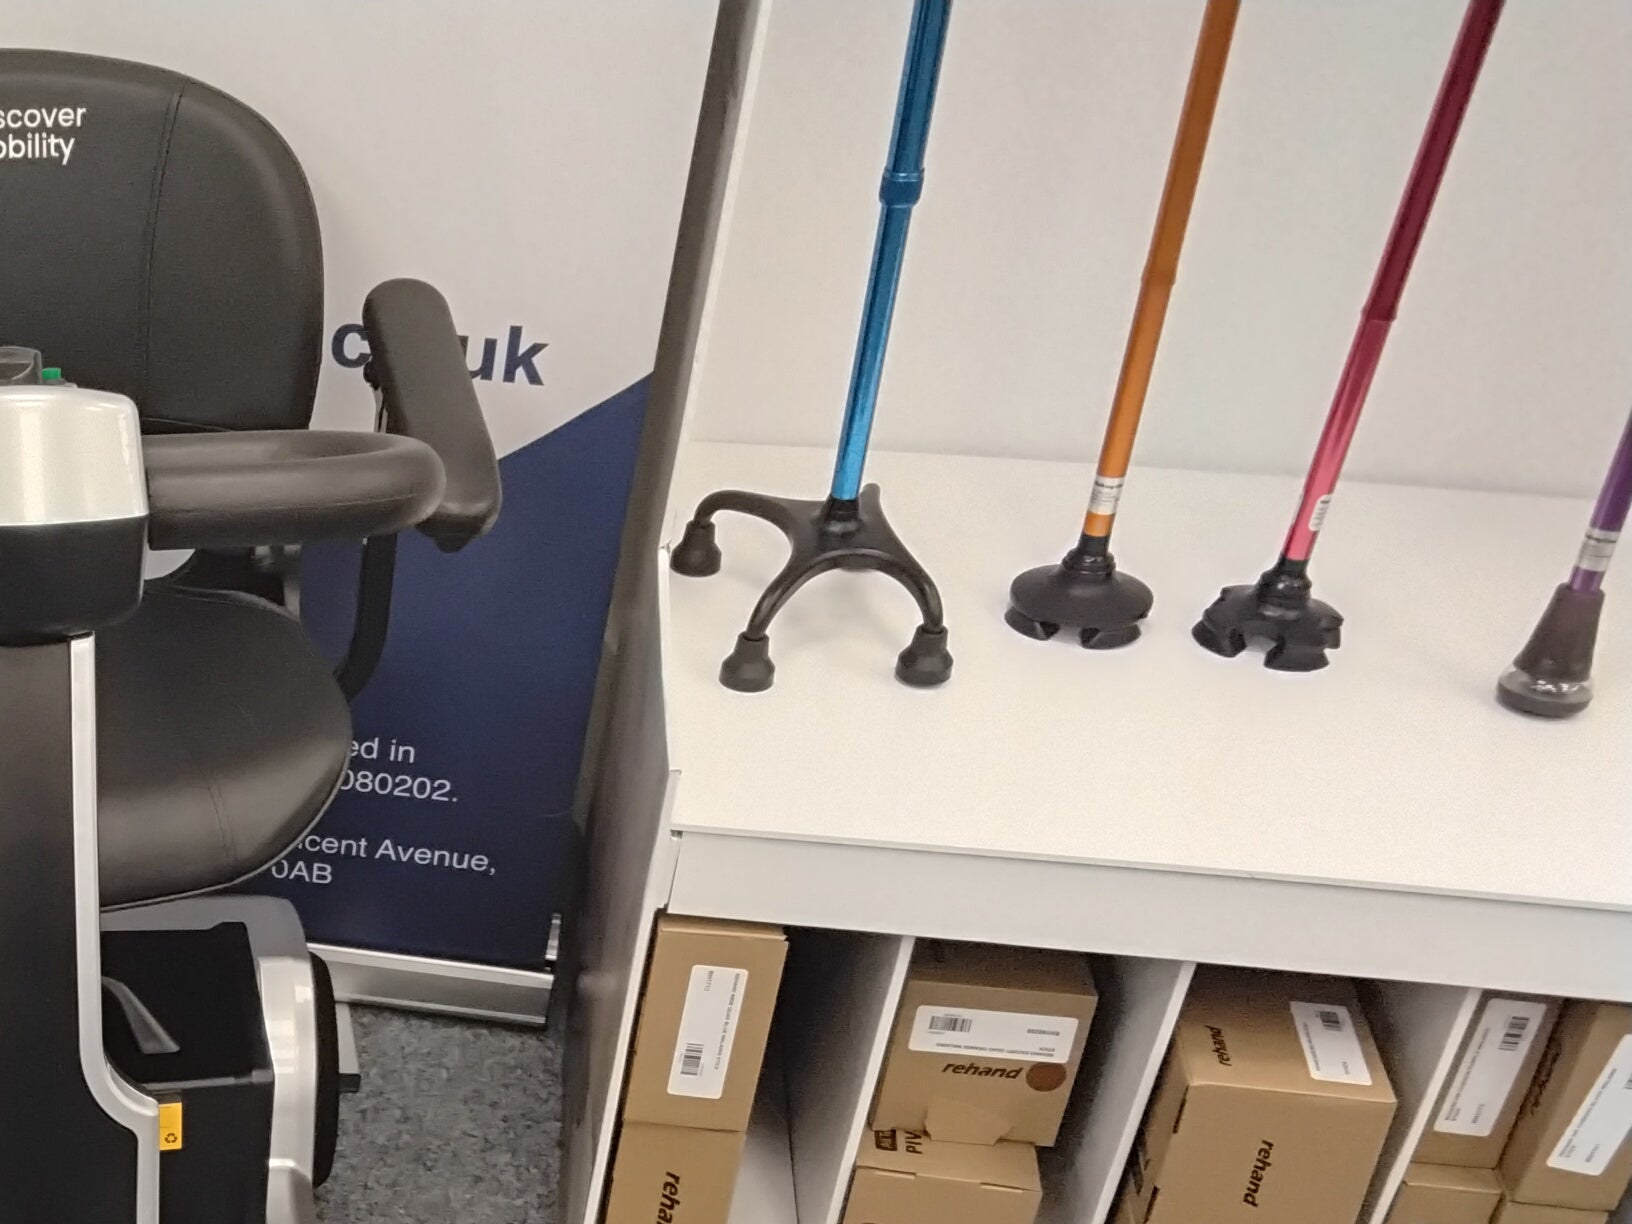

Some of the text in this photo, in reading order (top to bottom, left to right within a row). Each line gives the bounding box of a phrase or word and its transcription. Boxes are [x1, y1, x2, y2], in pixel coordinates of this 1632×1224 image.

[389, 739, 415, 763] in
[374, 839, 496, 876] Avenue,
[1205, 1024, 1232, 1067] rehand
[941, 1063, 1023, 1080] rehand
[1243, 1140, 1274, 1208] rehand
